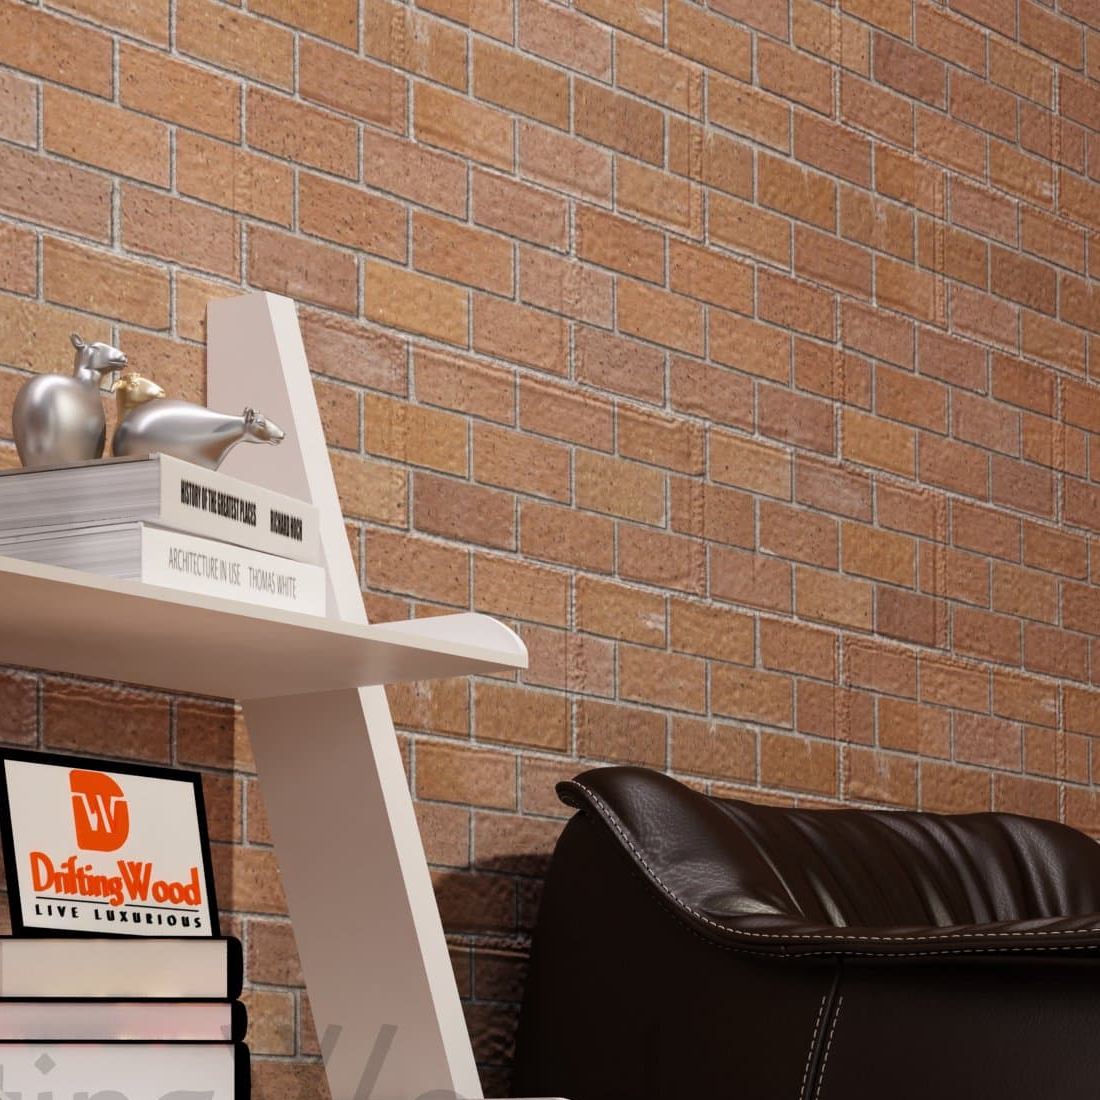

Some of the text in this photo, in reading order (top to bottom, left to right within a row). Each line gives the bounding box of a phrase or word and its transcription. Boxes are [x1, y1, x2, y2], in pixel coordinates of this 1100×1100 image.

[180, 479, 201, 509] HISTORY
[208, 488, 217, 514] THE
[169, 547, 297, 599] ARCHITECTURE IN USE THOMAS WHITE
[35, 904, 202, 928] LIVE LUXURIOUS
